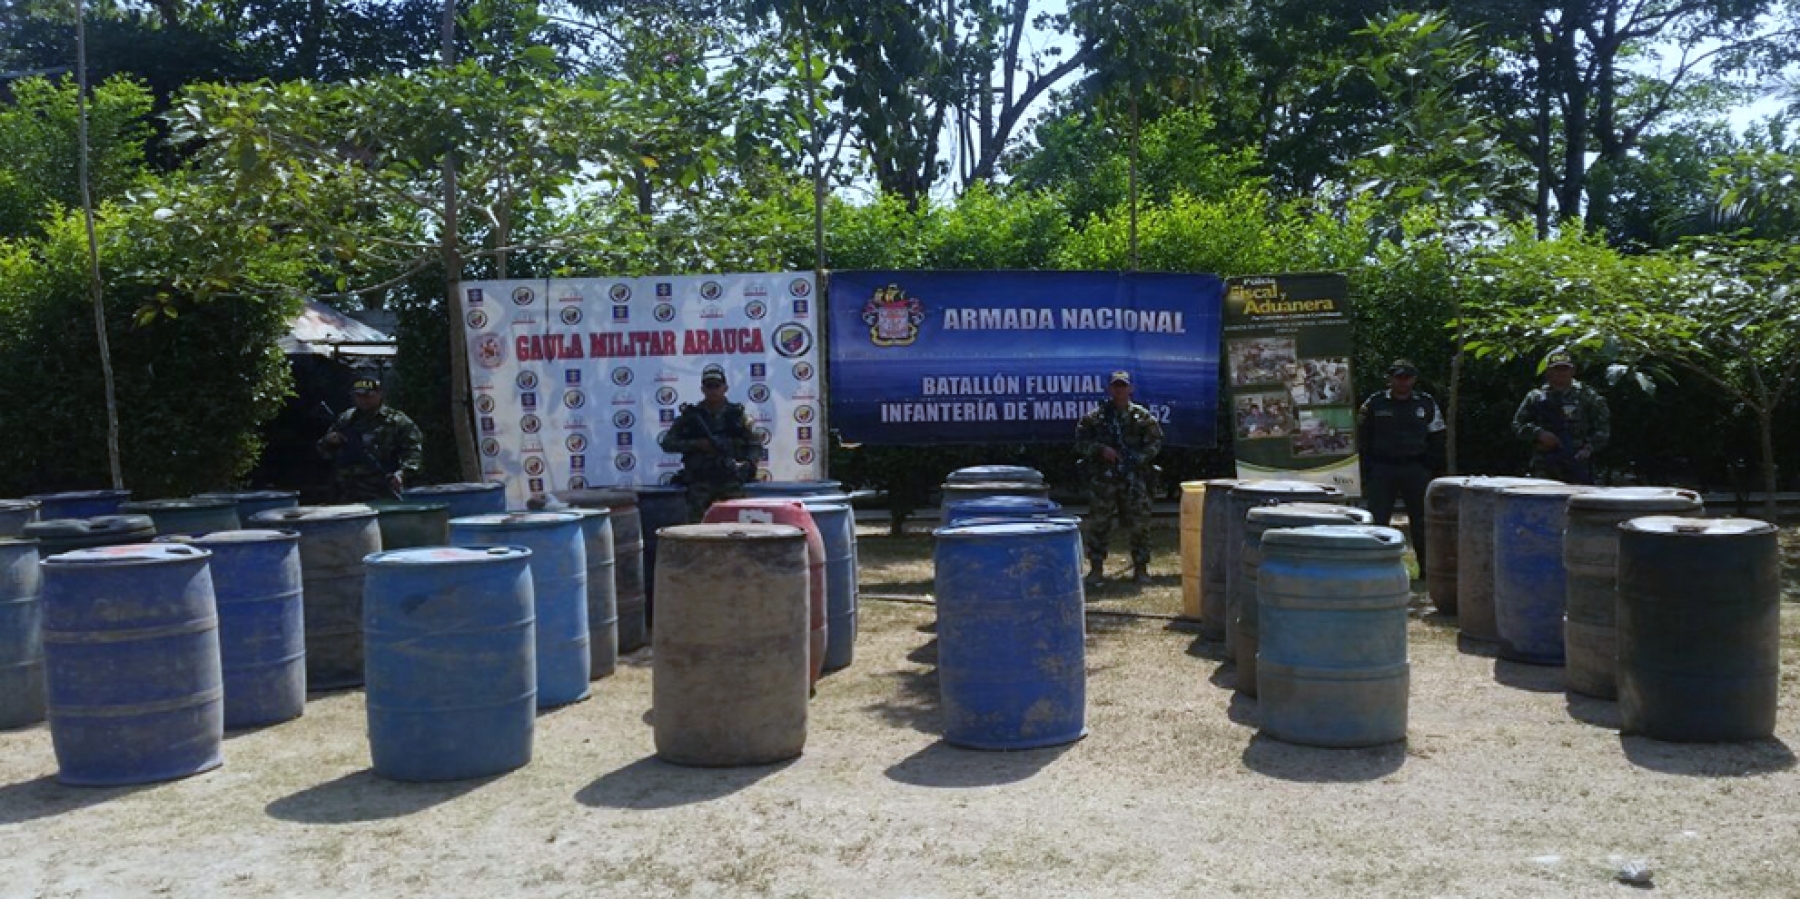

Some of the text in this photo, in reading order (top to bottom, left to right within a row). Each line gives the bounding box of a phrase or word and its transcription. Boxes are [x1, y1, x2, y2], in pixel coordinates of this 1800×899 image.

[1231, 284, 1277, 299] Fiscal
[1244, 299, 1334, 314] Aduanera
[944, 308, 1186, 333] ARMADA NACIONAL
[515, 327, 764, 362] GAULA MILITAR ARAUCA
[922, 372, 1105, 396] BATALLÓN FLUVIAL
[880, 399, 998, 423] INFANTERÍA
[1003, 402, 1029, 422] DE
[1032, 400, 1100, 420] MARIN
